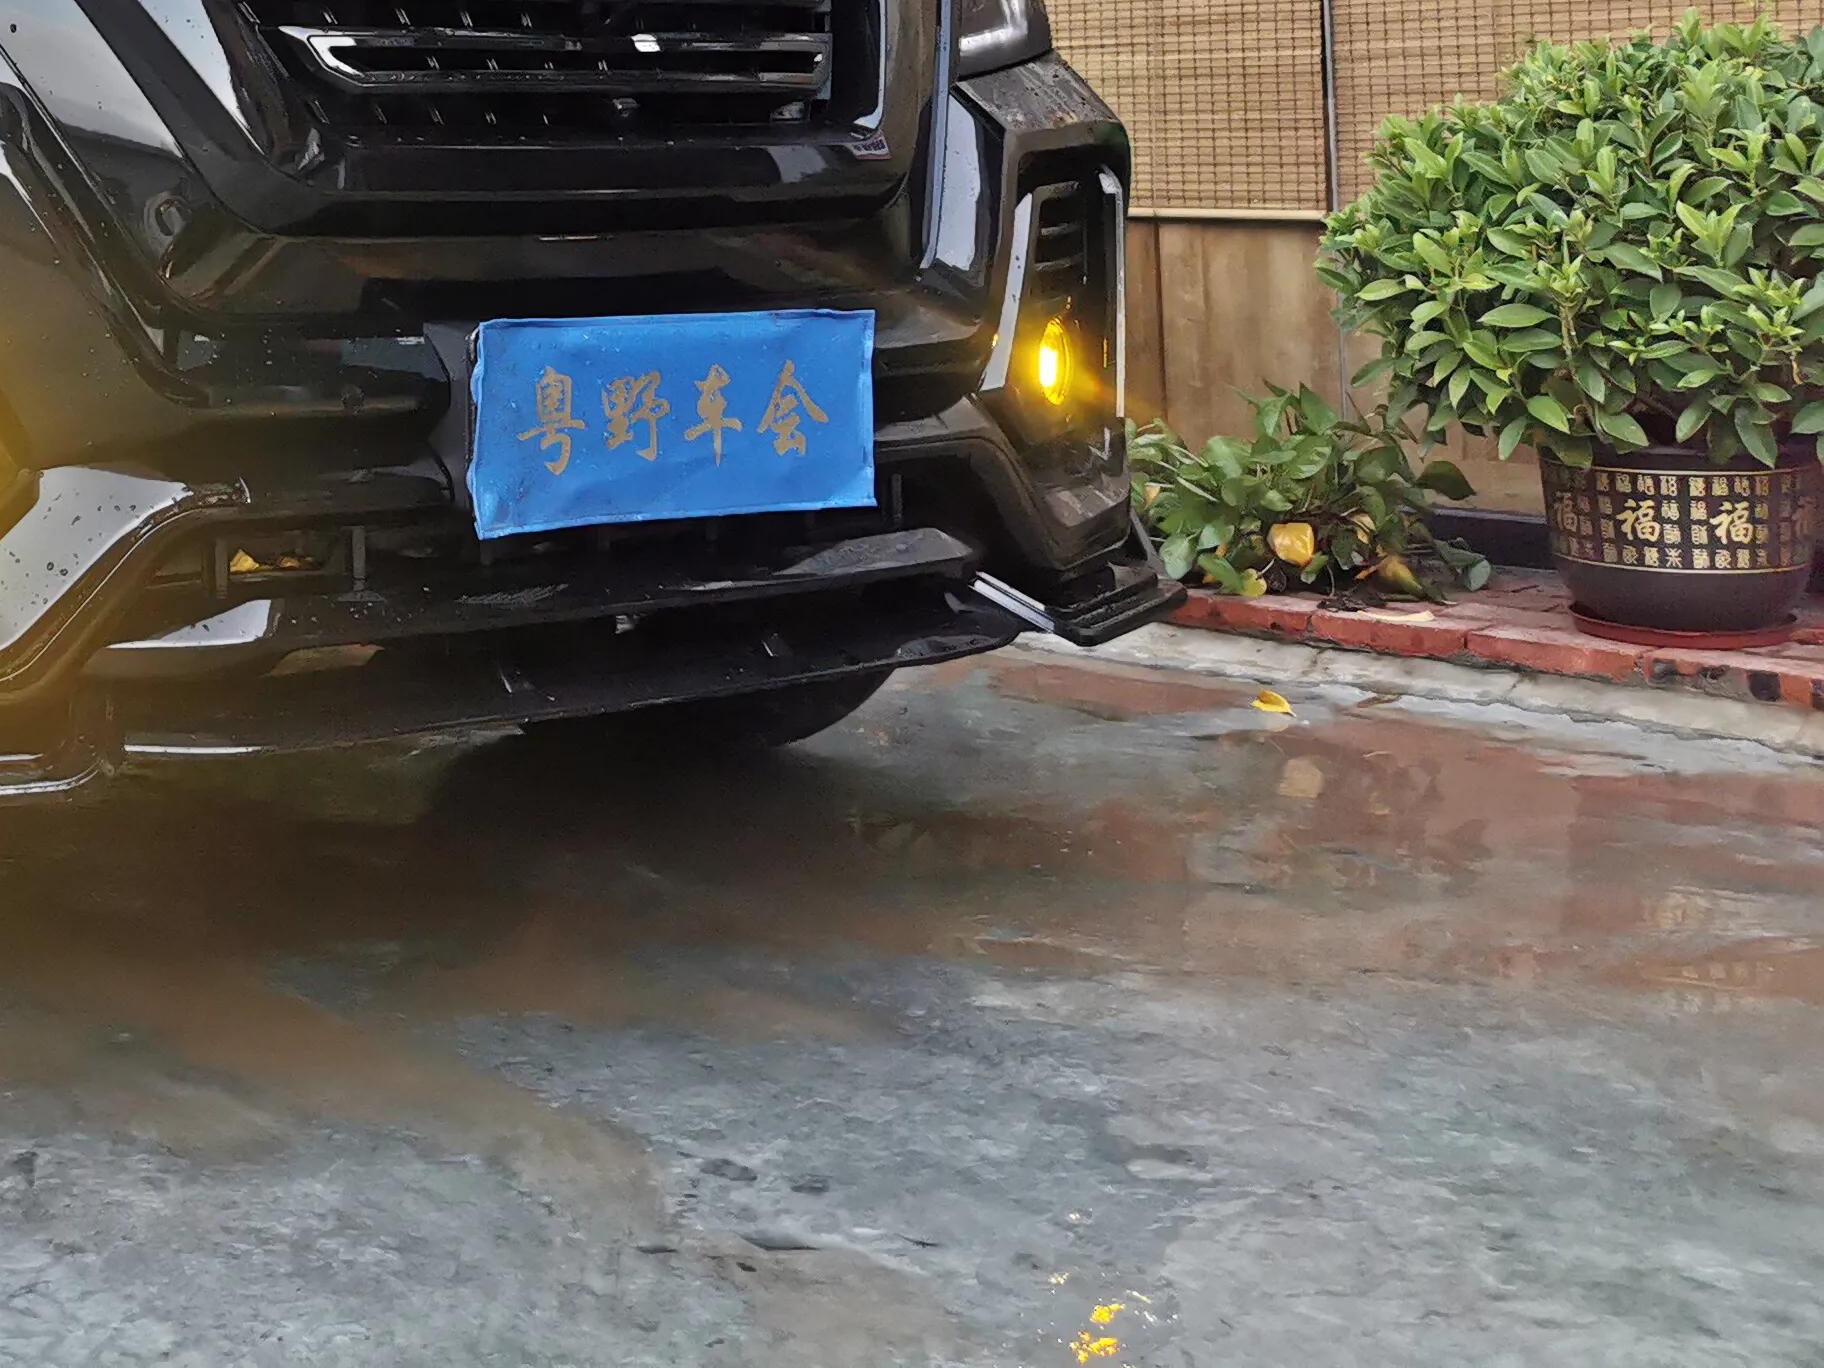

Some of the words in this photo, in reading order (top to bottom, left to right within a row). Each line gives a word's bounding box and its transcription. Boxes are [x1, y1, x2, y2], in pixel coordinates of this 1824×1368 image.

[518, 360, 829, 476] 粤野车会
[1616, 499, 1661, 541] 福
[1710, 501, 1754, 544] 福
